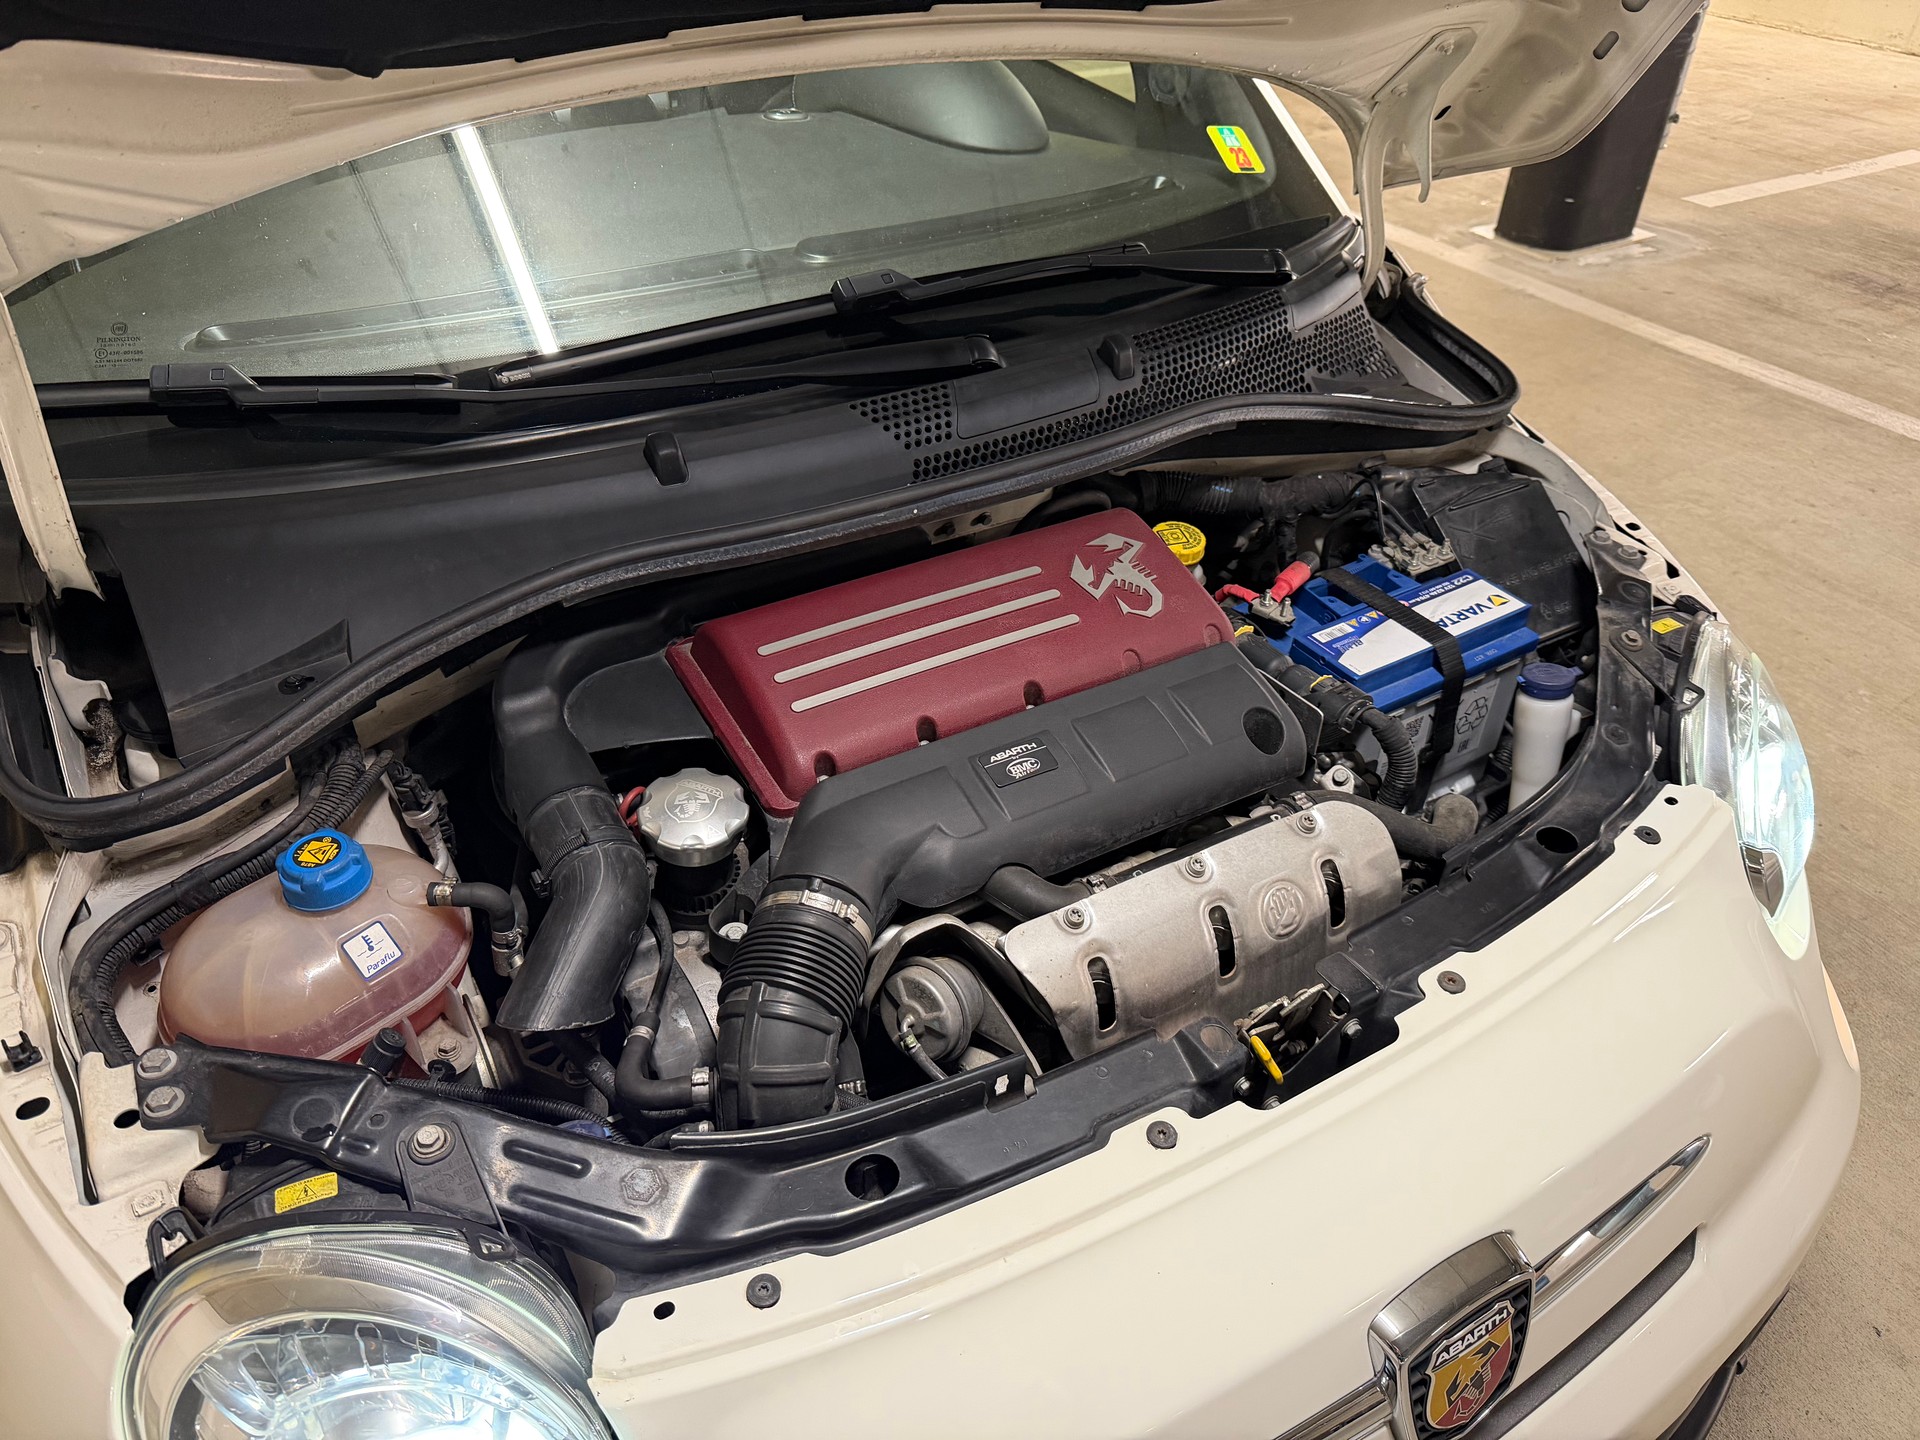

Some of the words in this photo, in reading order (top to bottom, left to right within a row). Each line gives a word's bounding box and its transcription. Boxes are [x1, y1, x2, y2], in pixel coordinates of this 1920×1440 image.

[1229, 147, 1252, 168] 23
[1435, 603, 1493, 629] VARTA
[990, 742, 1037, 763] ABARTH
[1009, 759, 1038, 775] BMC
[683, 780, 721, 797] ABARTH
[366, 951, 396, 974] Paraflu
[1435, 1308, 1508, 1366] ABARTH
